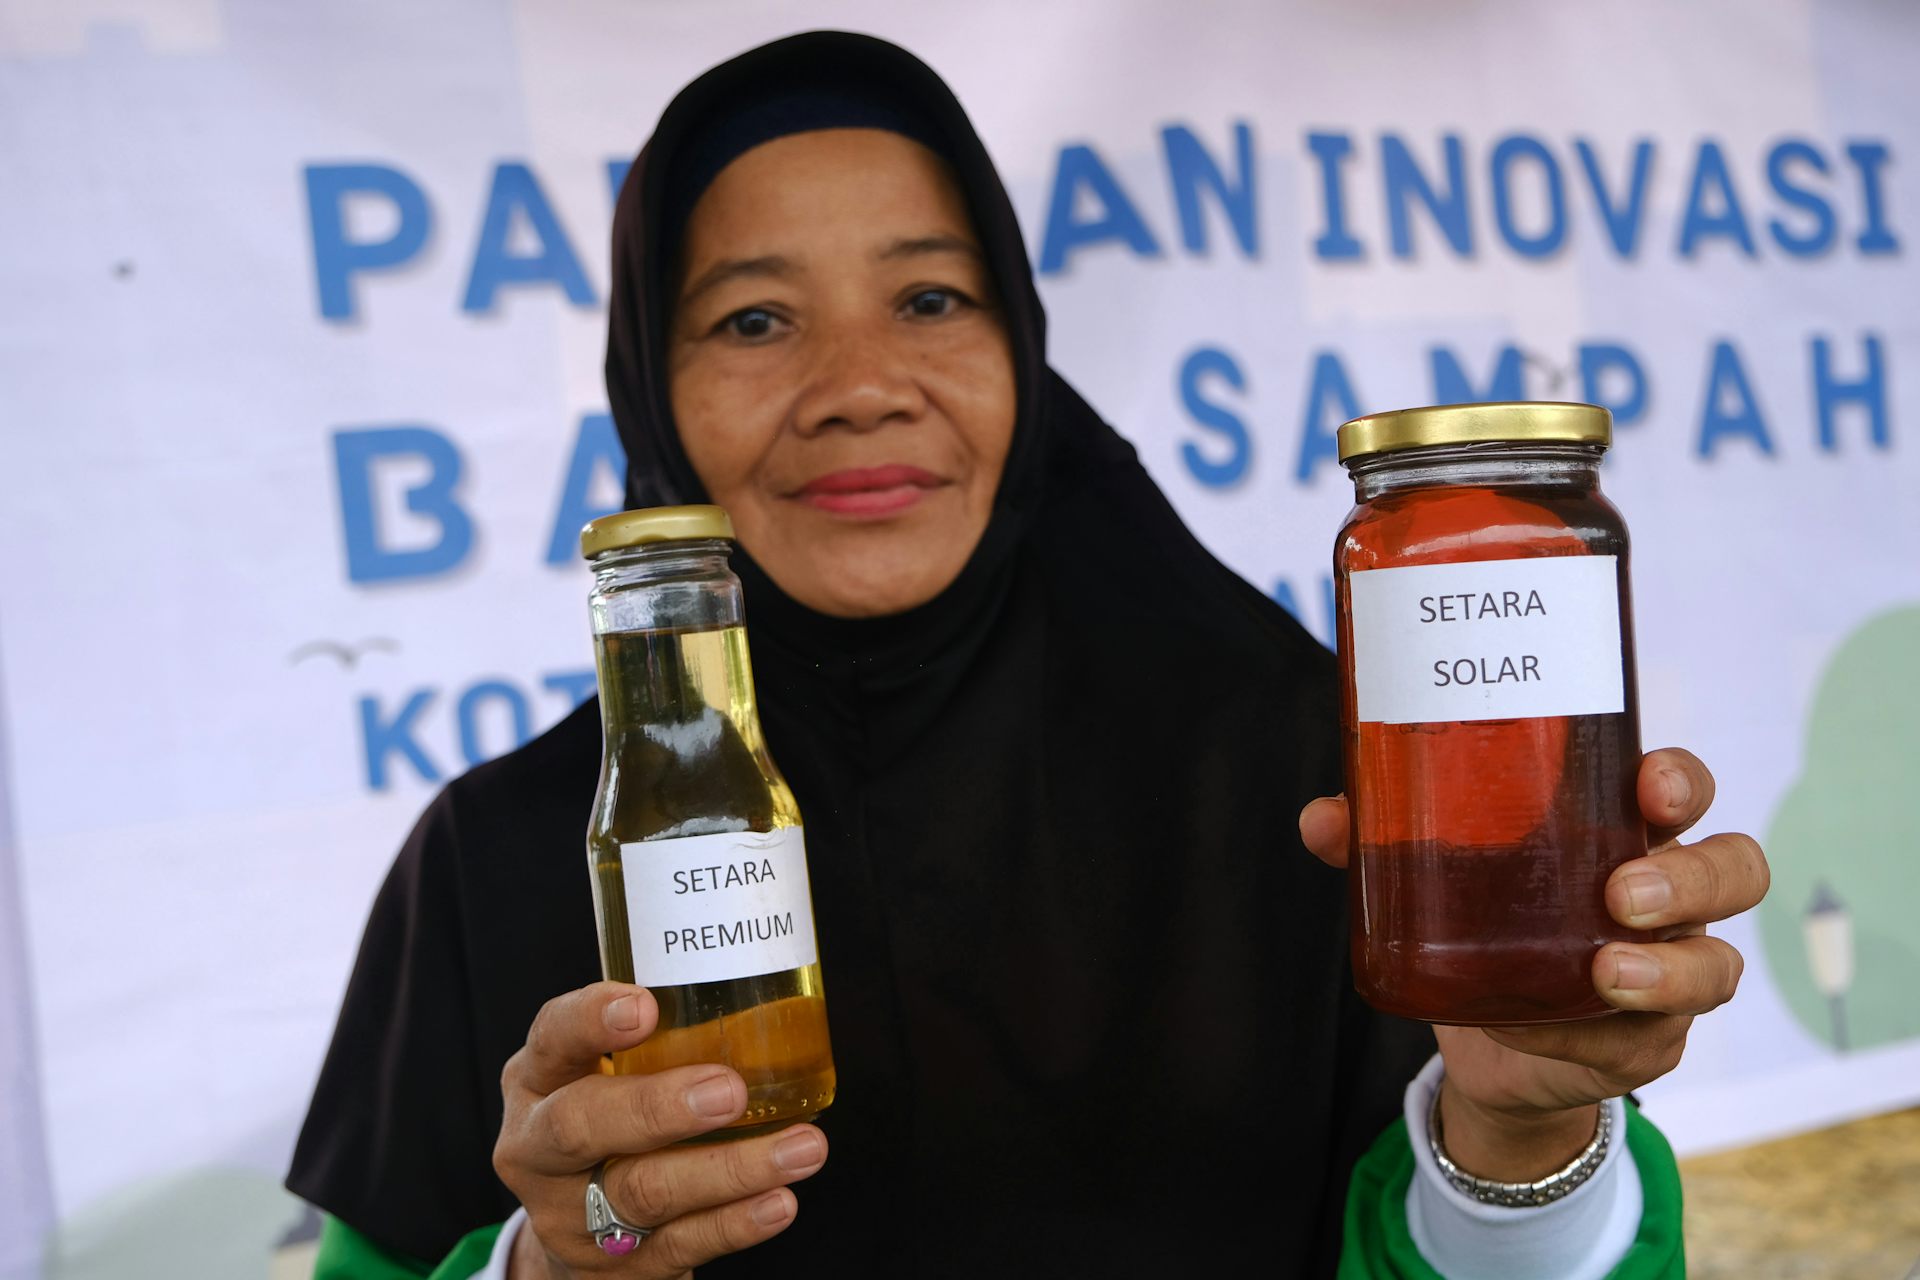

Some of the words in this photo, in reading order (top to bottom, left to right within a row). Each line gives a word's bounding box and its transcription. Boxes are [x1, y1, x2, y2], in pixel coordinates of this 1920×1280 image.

[301, 122, 1259, 322] PAAN
[1305, 131, 1899, 260] INOVASI
[1419, 590, 1546, 623] SETARA
[1433, 655, 1541, 687] SOLAR
[673, 858, 776, 895] SETARA
[664, 912, 794, 954] PREMIUM
